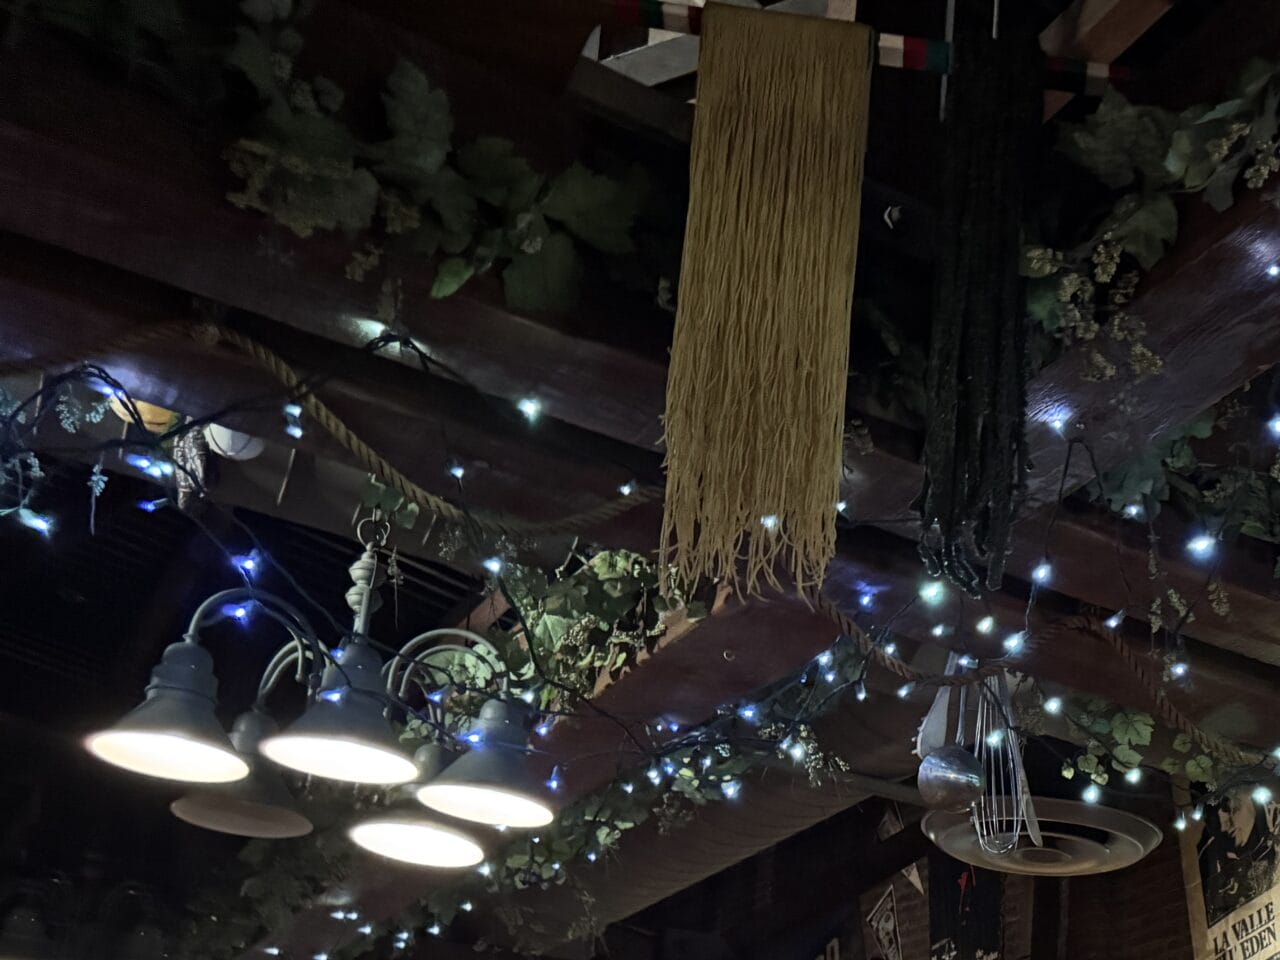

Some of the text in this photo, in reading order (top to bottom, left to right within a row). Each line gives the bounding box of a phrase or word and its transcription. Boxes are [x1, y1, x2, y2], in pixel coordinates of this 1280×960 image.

[1213, 901, 1276, 956] LA VALLE
[1239, 923, 1277, 960] EDEN
